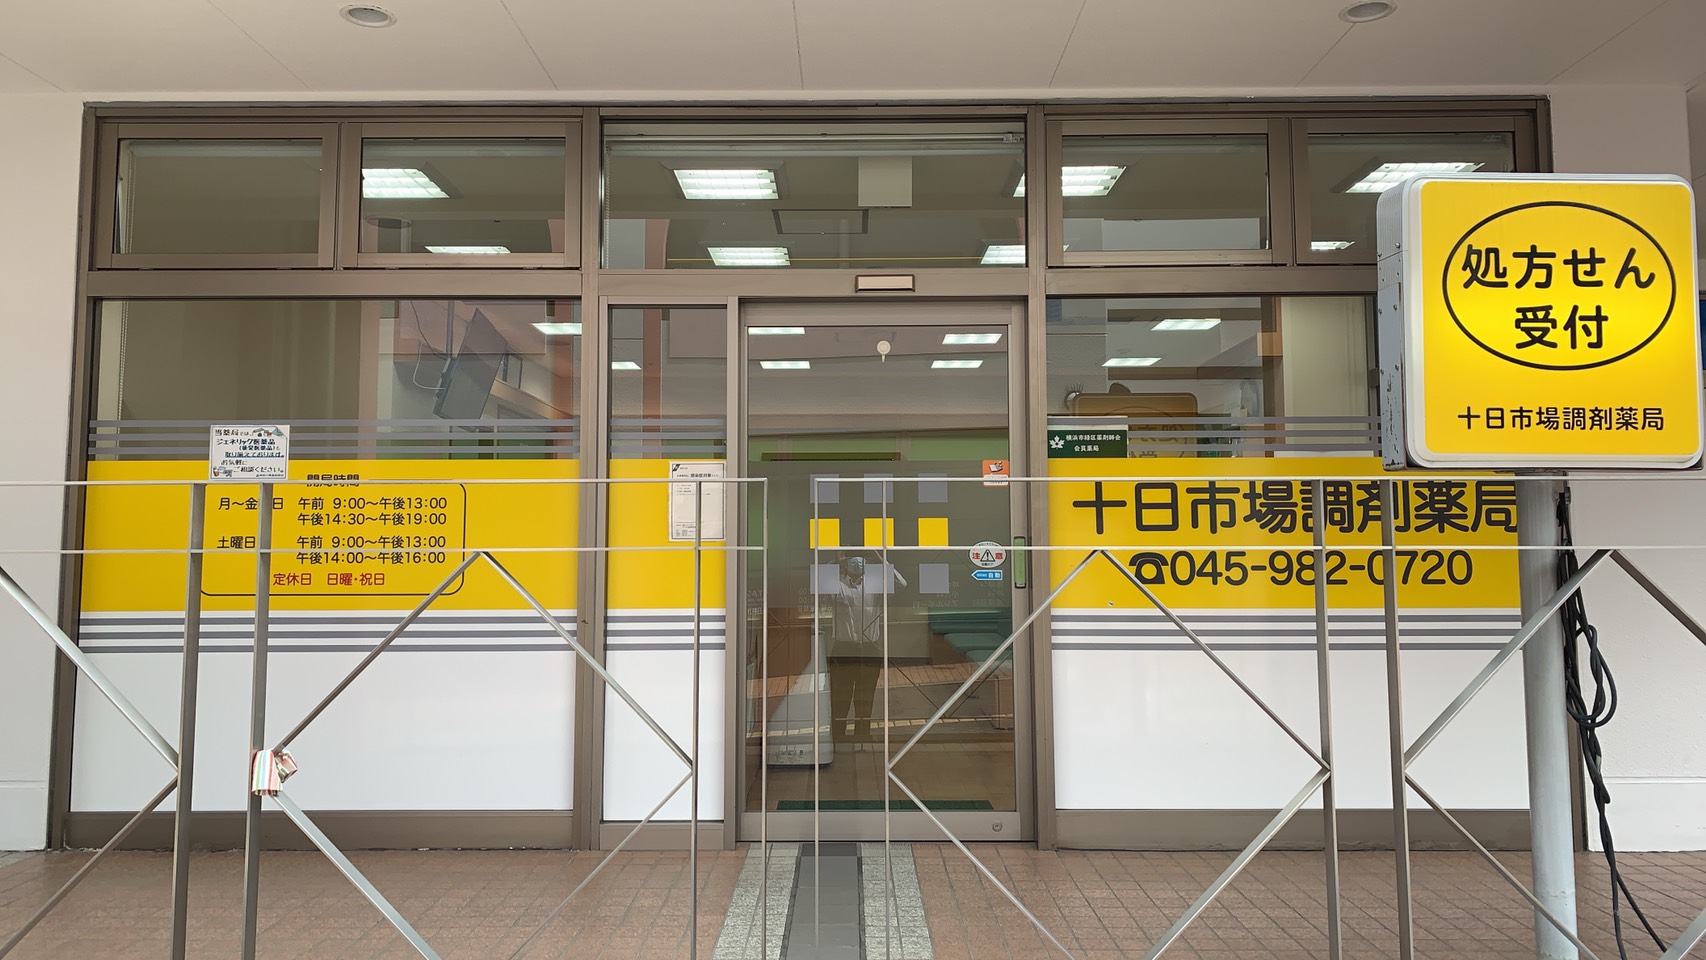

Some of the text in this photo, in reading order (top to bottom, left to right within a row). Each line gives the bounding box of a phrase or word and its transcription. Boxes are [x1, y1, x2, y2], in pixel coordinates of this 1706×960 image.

[1462, 244, 1656, 289] 処方せん
[1515, 304, 1609, 350] 受付
[1458, 406, 1664, 431] 十日市場調剤薬局
[217, 438, 276, 446] ジェネリック医薬品
[218, 497, 448, 511] 月～金日 午前 9:00～午後13:00
[1072, 480, 1518, 535] 十日市場調剤薬局
[297, 513, 447, 526] 午後14:30～午後19:00
[217, 536, 447, 549] 土曜日 午前 9:00～午後13:00
[296, 551, 446, 564] 午後14:00～午後16:00
[1170, 550, 1473, 585] 045-982-0720
[273, 573, 385, 586] 定休日 日曜・祝日
